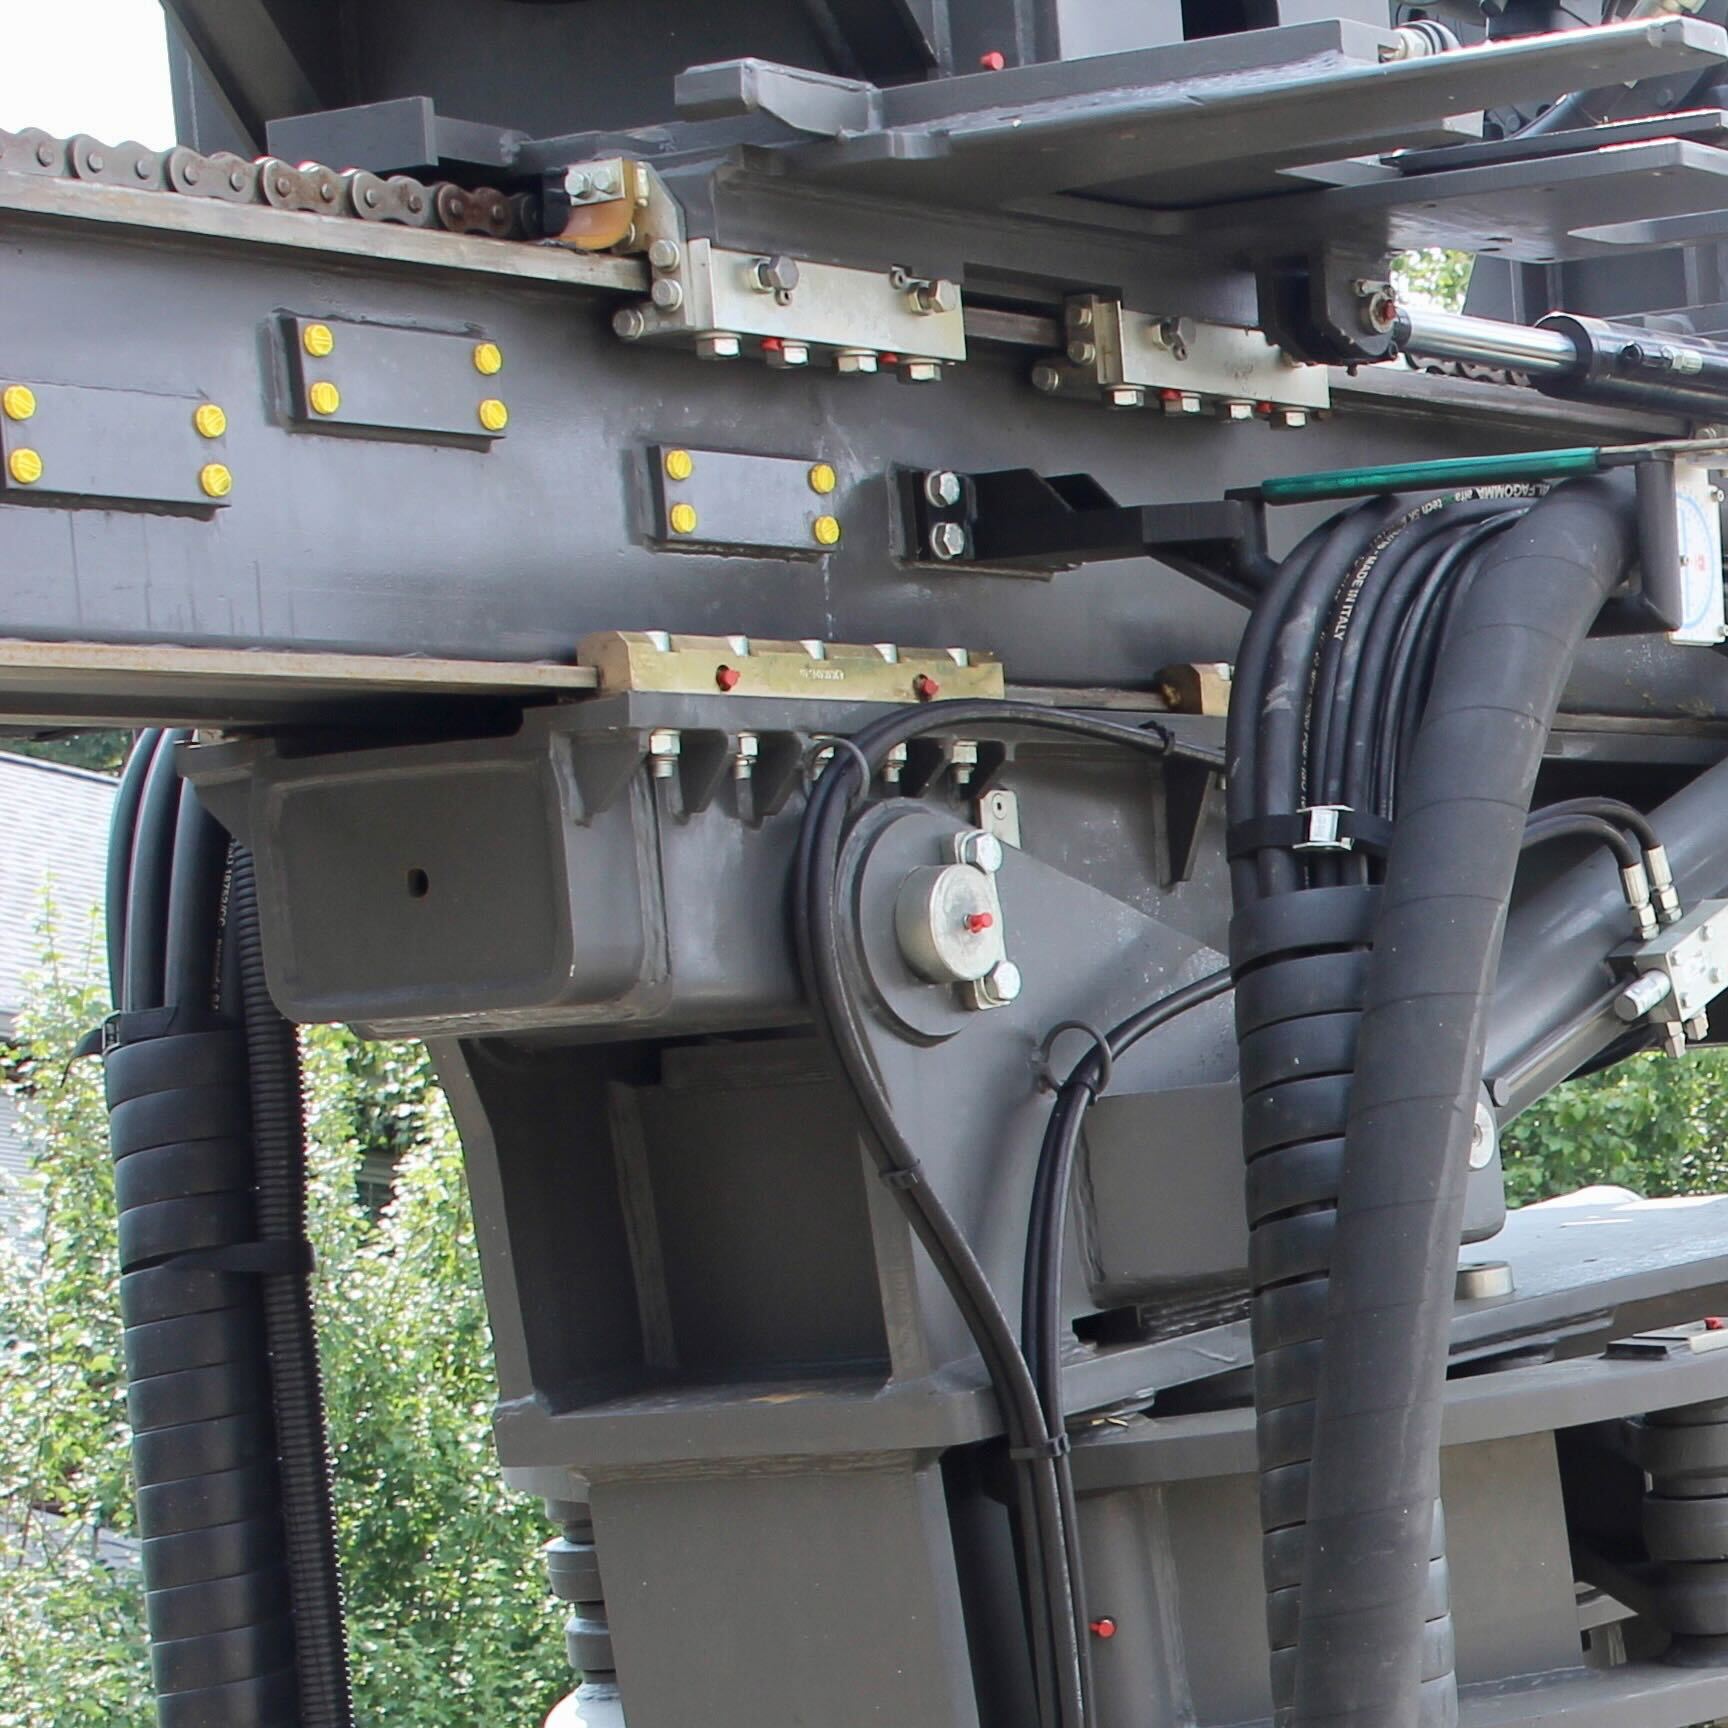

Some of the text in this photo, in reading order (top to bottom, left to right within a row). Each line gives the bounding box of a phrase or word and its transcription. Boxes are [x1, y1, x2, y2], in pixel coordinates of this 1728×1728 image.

[1476, 483, 1550, 499] ALFAGOMMA
[1333, 555, 1377, 641] MADE IN ITALY
